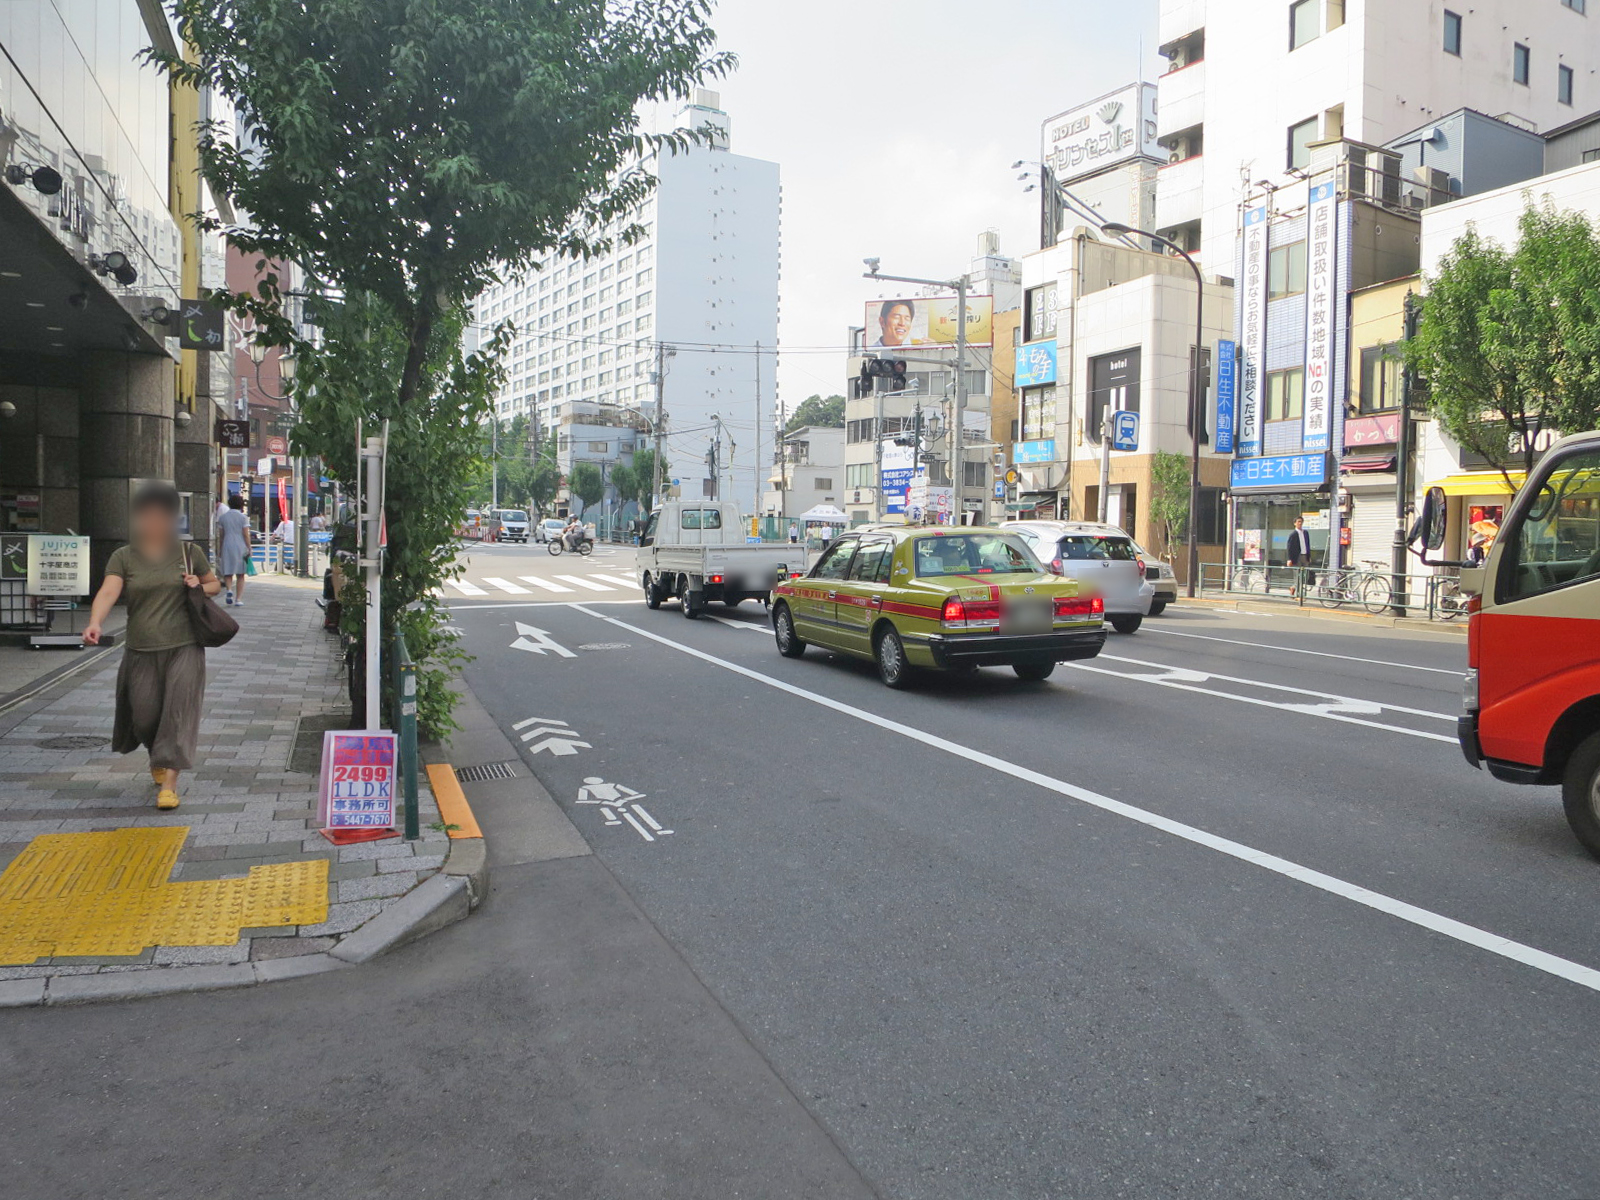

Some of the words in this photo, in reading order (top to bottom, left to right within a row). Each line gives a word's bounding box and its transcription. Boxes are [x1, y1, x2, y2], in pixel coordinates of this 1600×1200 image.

[1052, 114, 1091, 143] HOTEL
[1243, 227, 1260, 438] 不動産の事ならお気軽にご相談ください
[1109, 358, 1128, 371] hotel
[1217, 360, 1232, 448] 日生不動産
[1238, 443, 1259, 455] nissei
[1304, 437, 1327, 449] nissei
[1247, 456, 1322, 479] 日生不動産
[39, 561, 78, 569] 十字屋商店
[334, 766, 387, 782] 2499
[334, 781, 390, 798] 1LDK
[334, 799, 389, 811] 事務所可
[344, 815, 390, 826] 5447-7670
